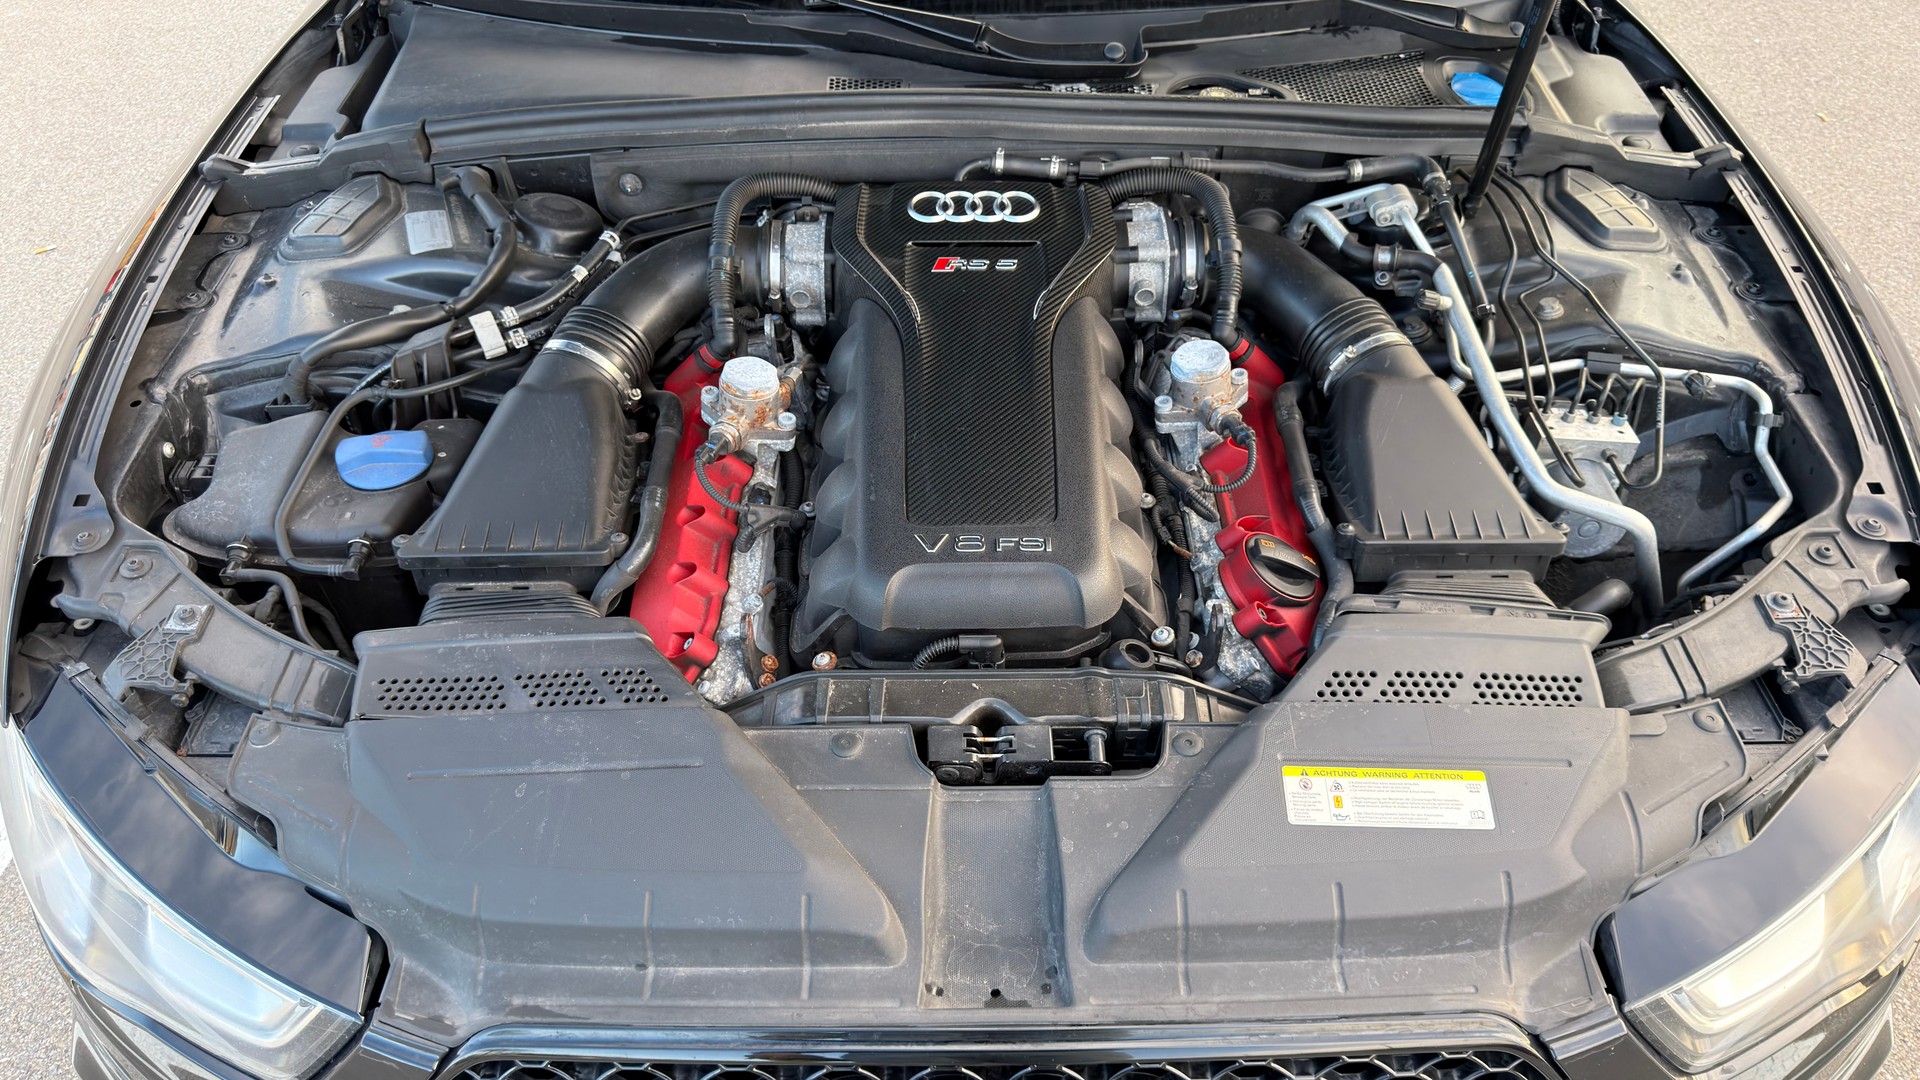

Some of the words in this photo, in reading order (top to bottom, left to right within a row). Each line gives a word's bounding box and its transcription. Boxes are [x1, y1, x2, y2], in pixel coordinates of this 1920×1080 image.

[945, 258, 990, 270] RS
[995, 259, 1018, 270] 5
[914, 533, 986, 553] V8
[995, 537, 1052, 552] FSI
[1313, 770, 1358, 778] ACHTUNG
[1362, 771, 1408, 779] WARNING
[1413, 772, 1464, 780] ATTENTION
